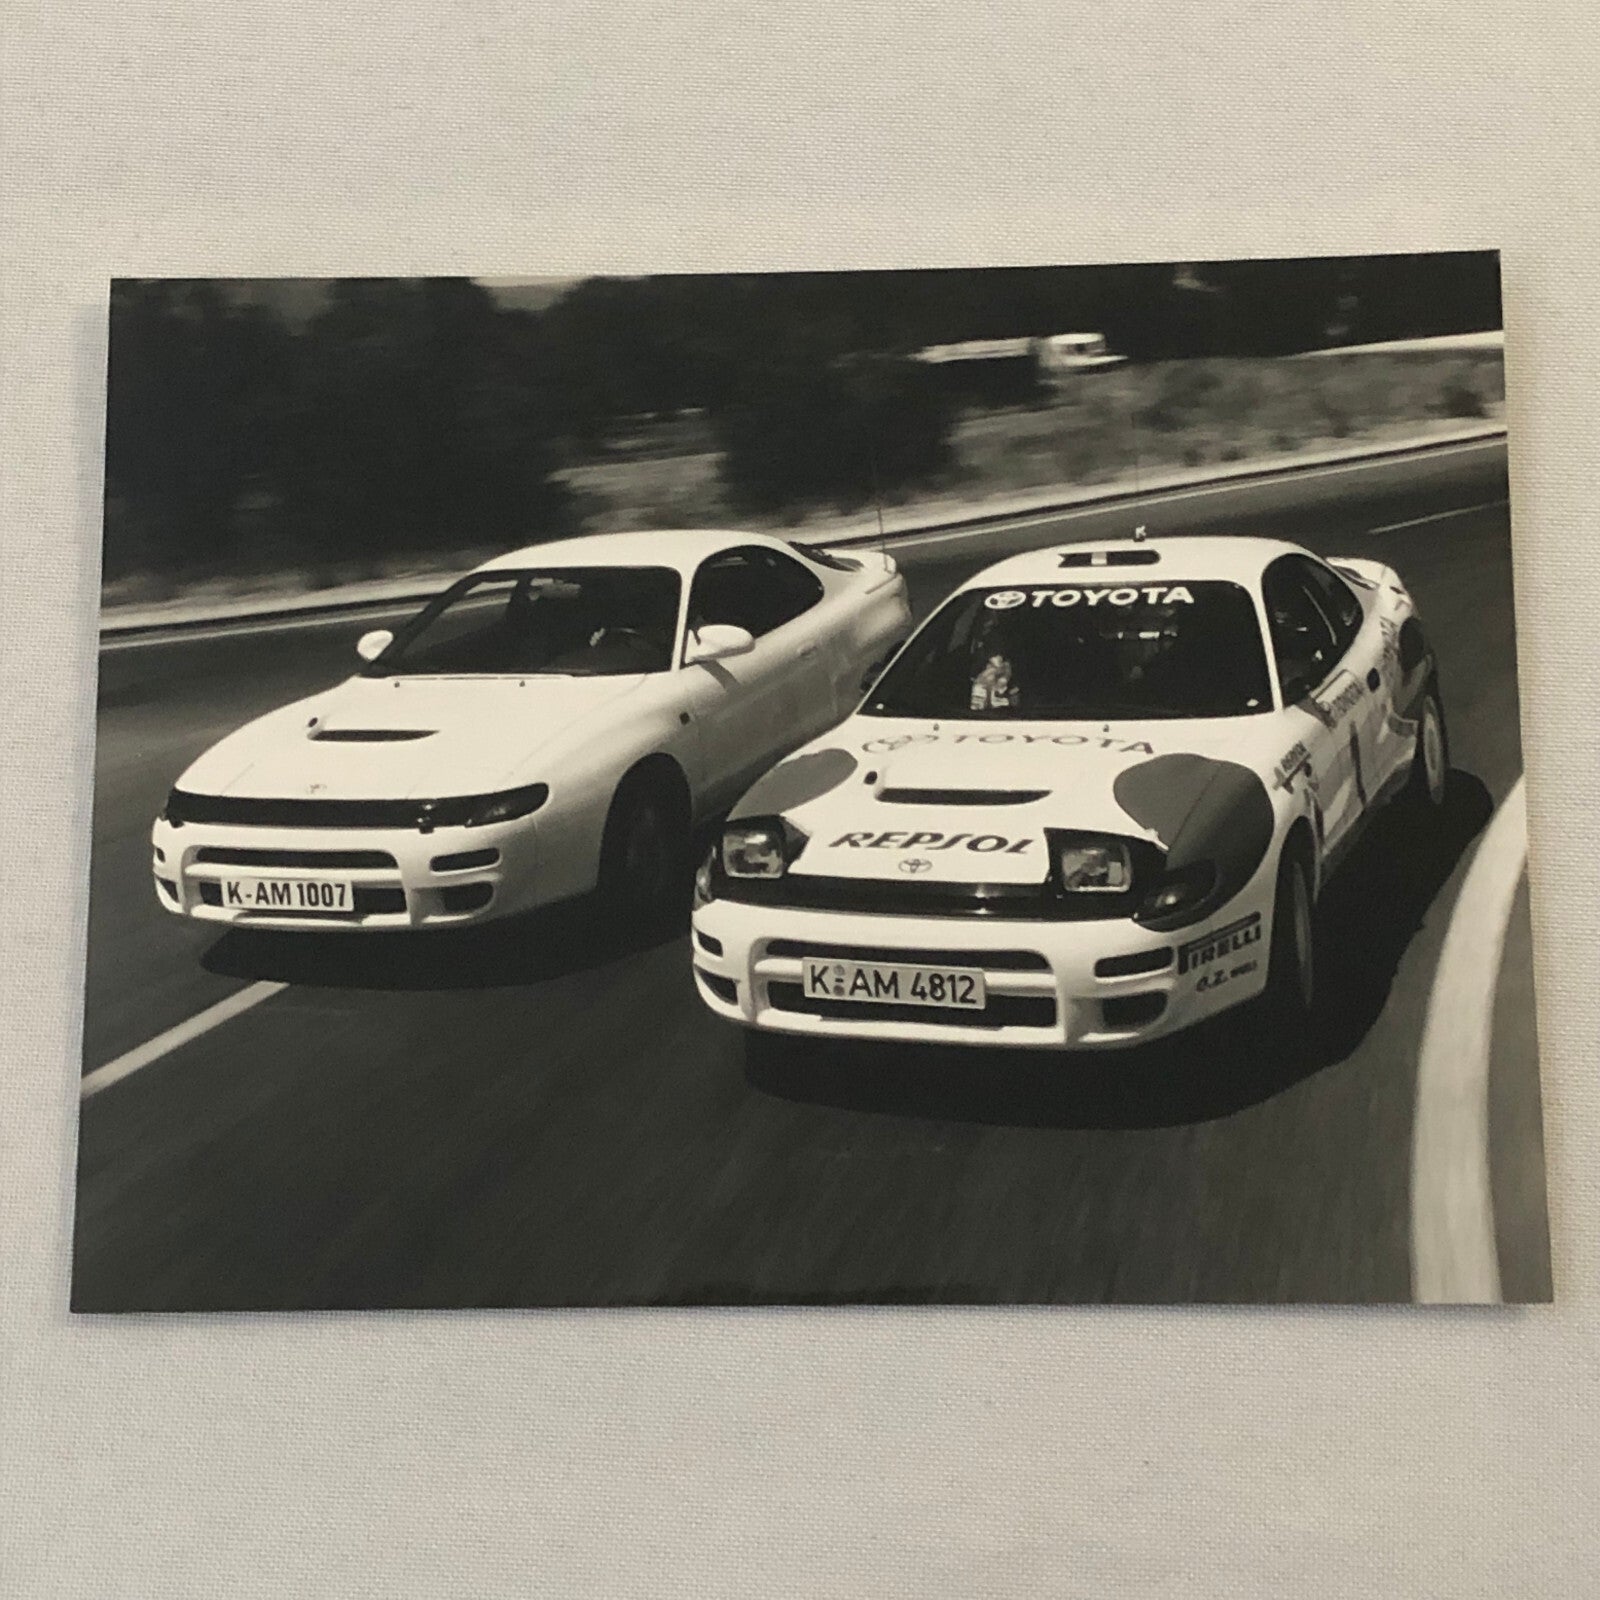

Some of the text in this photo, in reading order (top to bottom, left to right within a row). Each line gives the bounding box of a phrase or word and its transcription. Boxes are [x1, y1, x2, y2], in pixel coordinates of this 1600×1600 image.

[1031, 586, 1195, 608] TOYOTA
[953, 734, 1154, 755] TOYOTA
[828, 831, 1034, 854] REPSOL
[297, 882, 346, 908] 1007
[1177, 911, 1262, 975] PIRELLI
[910, 971, 977, 1005] 4812
